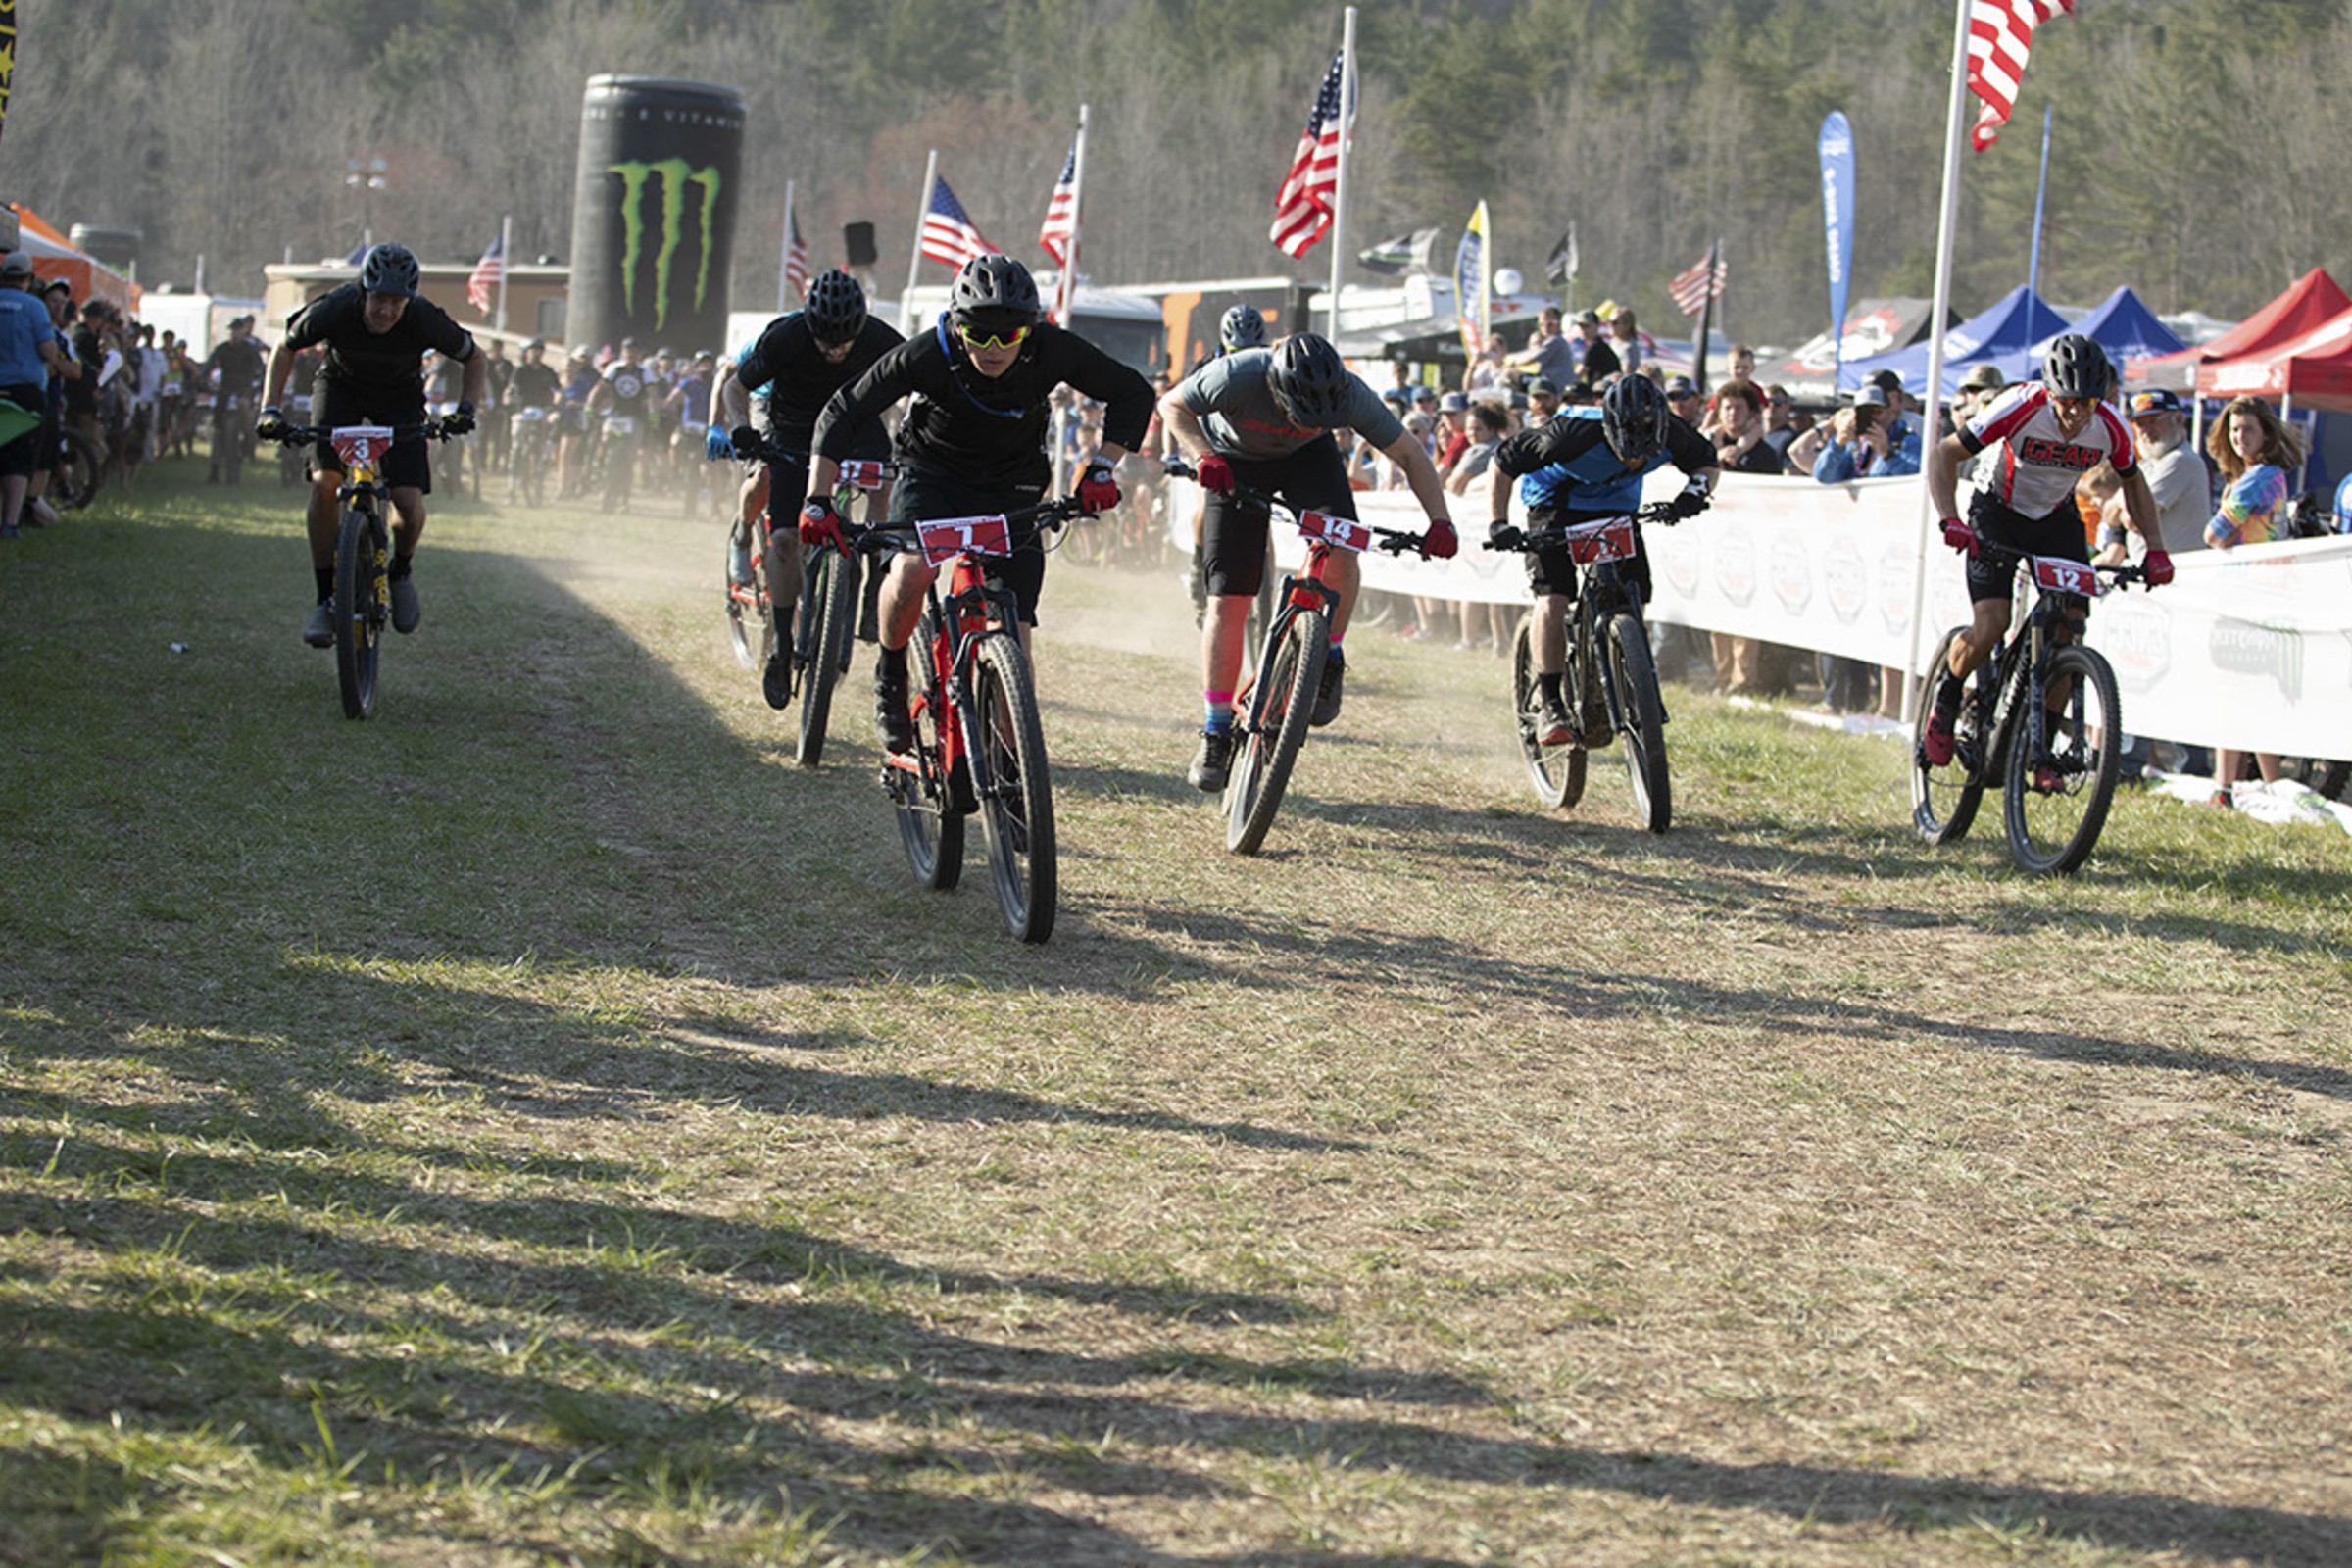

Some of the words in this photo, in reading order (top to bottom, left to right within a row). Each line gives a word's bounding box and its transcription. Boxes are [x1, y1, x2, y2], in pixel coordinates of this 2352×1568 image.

[353, 438, 369, 459] 3
[2024, 438, 2102, 467] GEAR
[954, 525, 973, 548] 7
[1322, 517, 1352, 541] 14
[2051, 568, 2082, 593] 12
